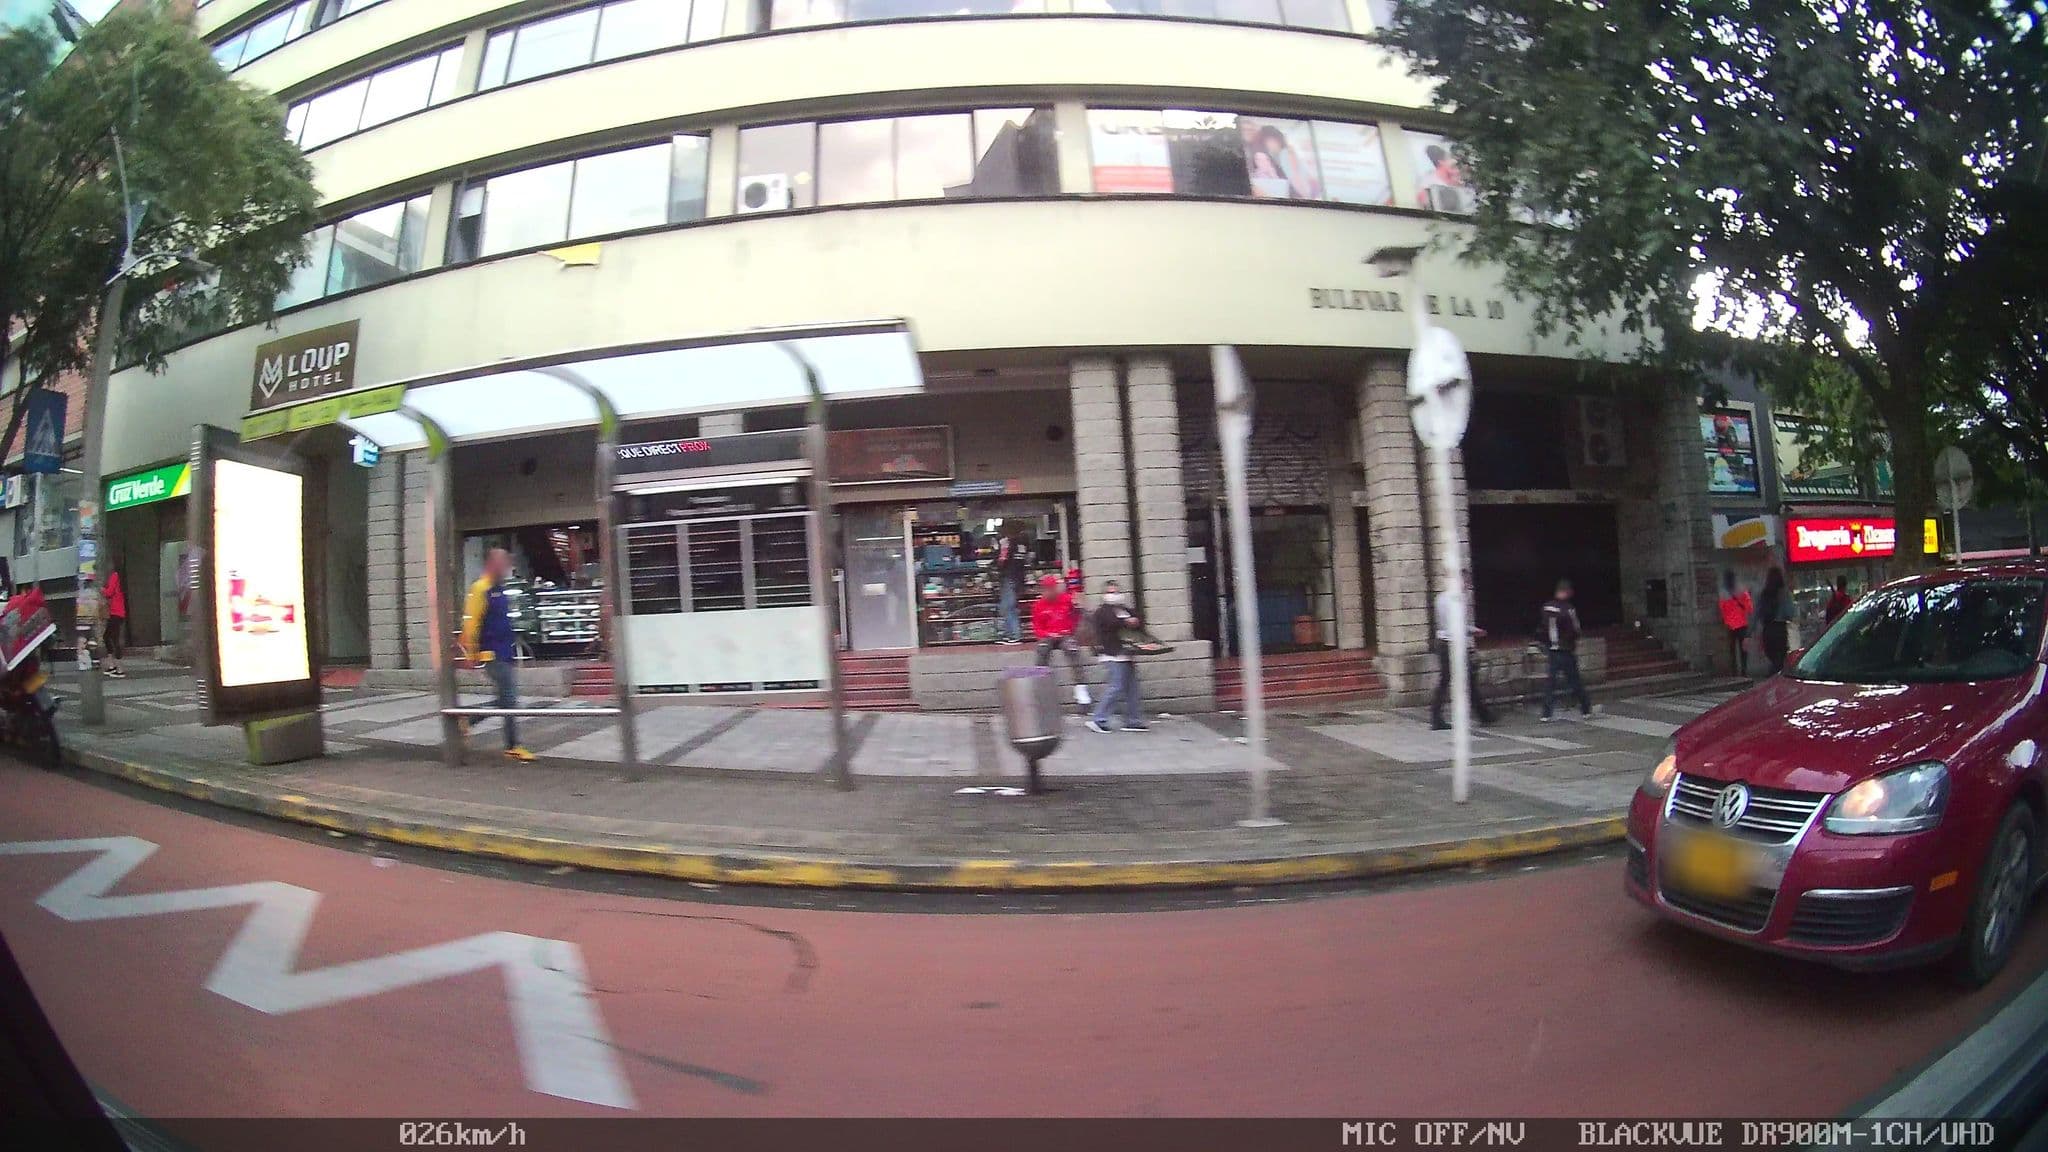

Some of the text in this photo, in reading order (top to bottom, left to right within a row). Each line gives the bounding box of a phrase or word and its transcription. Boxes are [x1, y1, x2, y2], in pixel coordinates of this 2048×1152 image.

[1309, 287, 1404, 313] BULEVAR
[1449, 296, 1477, 318] LA
[287, 342, 350, 377] LOUP
[288, 371, 343, 392] HOTEL
